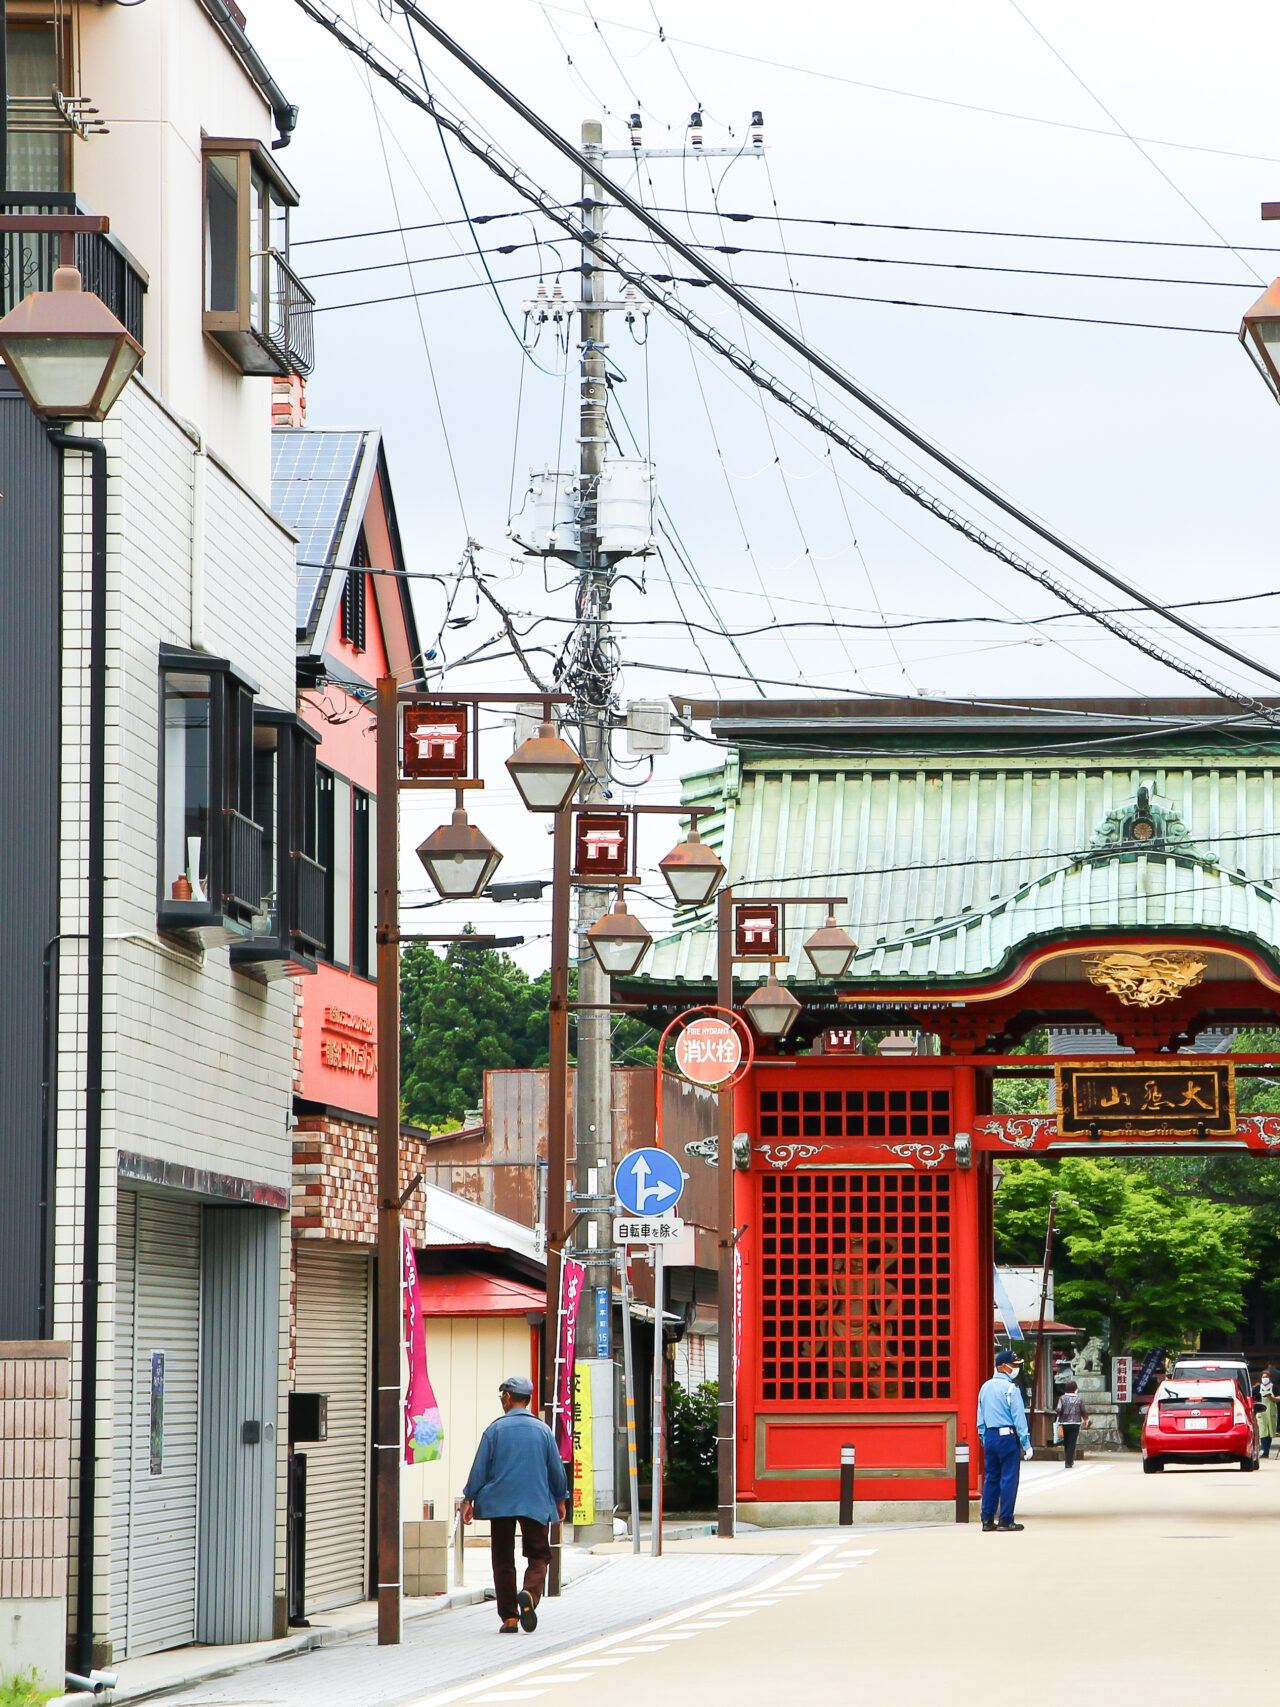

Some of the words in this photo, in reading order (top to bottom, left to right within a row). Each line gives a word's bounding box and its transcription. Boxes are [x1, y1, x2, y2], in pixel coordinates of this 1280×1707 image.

[687, 1028, 701, 1036] FIRE
[702, 1028, 729, 1036] HYDRANT
[682, 1039, 736, 1063] 消火栓
[618, 1224, 679, 1238] 自転車を除く
[1117, 1358, 1128, 1401] 有料駐車場
